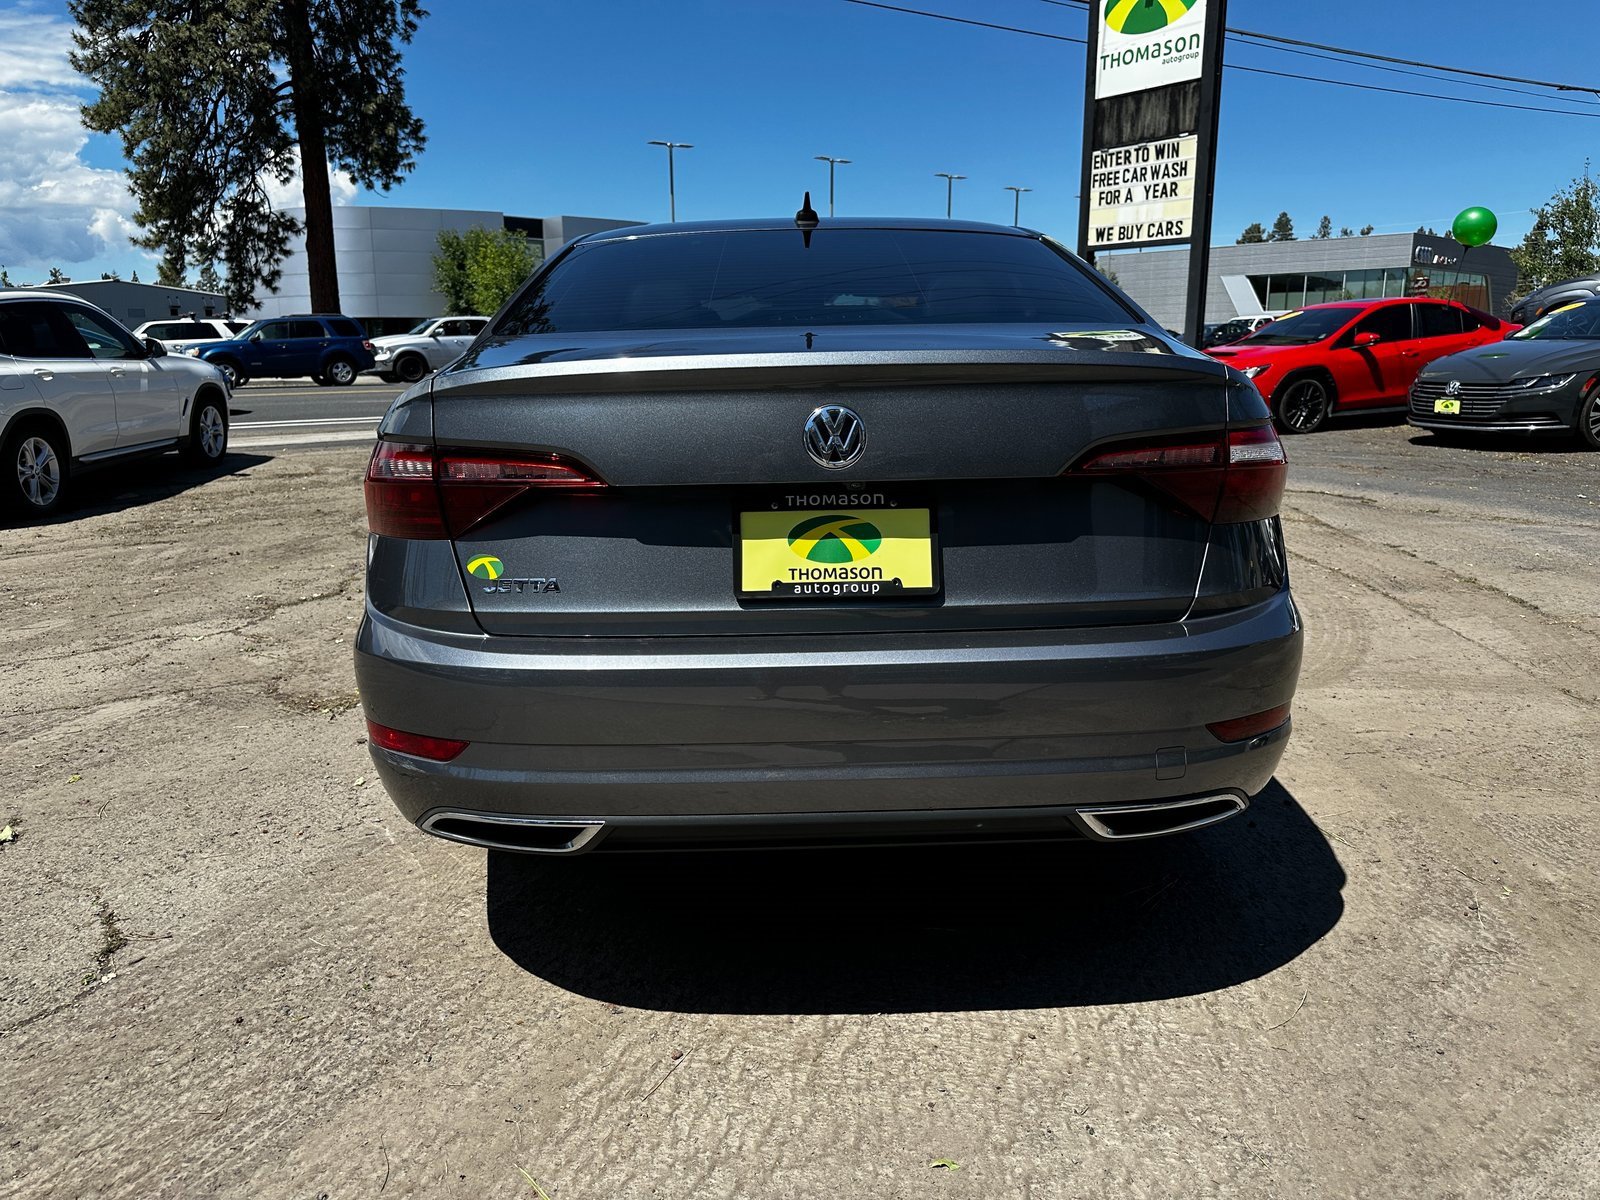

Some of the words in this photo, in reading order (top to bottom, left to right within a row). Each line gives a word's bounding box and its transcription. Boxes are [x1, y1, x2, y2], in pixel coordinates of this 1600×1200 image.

[1161, 51, 1200, 65] autogroup
[1093, 149, 1132, 170] ENTER
[1134, 147, 1150, 163] TO
[1154, 142, 1180, 160] WIN
[1092, 171, 1120, 189] FREE
[1122, 166, 1148, 183] CAR
[1150, 160, 1188, 181] WASH
[1098, 189, 1121, 207] FOR
[1124, 188, 1133, 203] A
[1143, 181, 1178, 200] YEAR
[1095, 227, 1114, 243] WE
[1118, 224, 1143, 241] BUY
[1147, 220, 1183, 238] CARS
[482, 577, 561, 594] JETTA
[793, 582, 880, 596] autogroup
